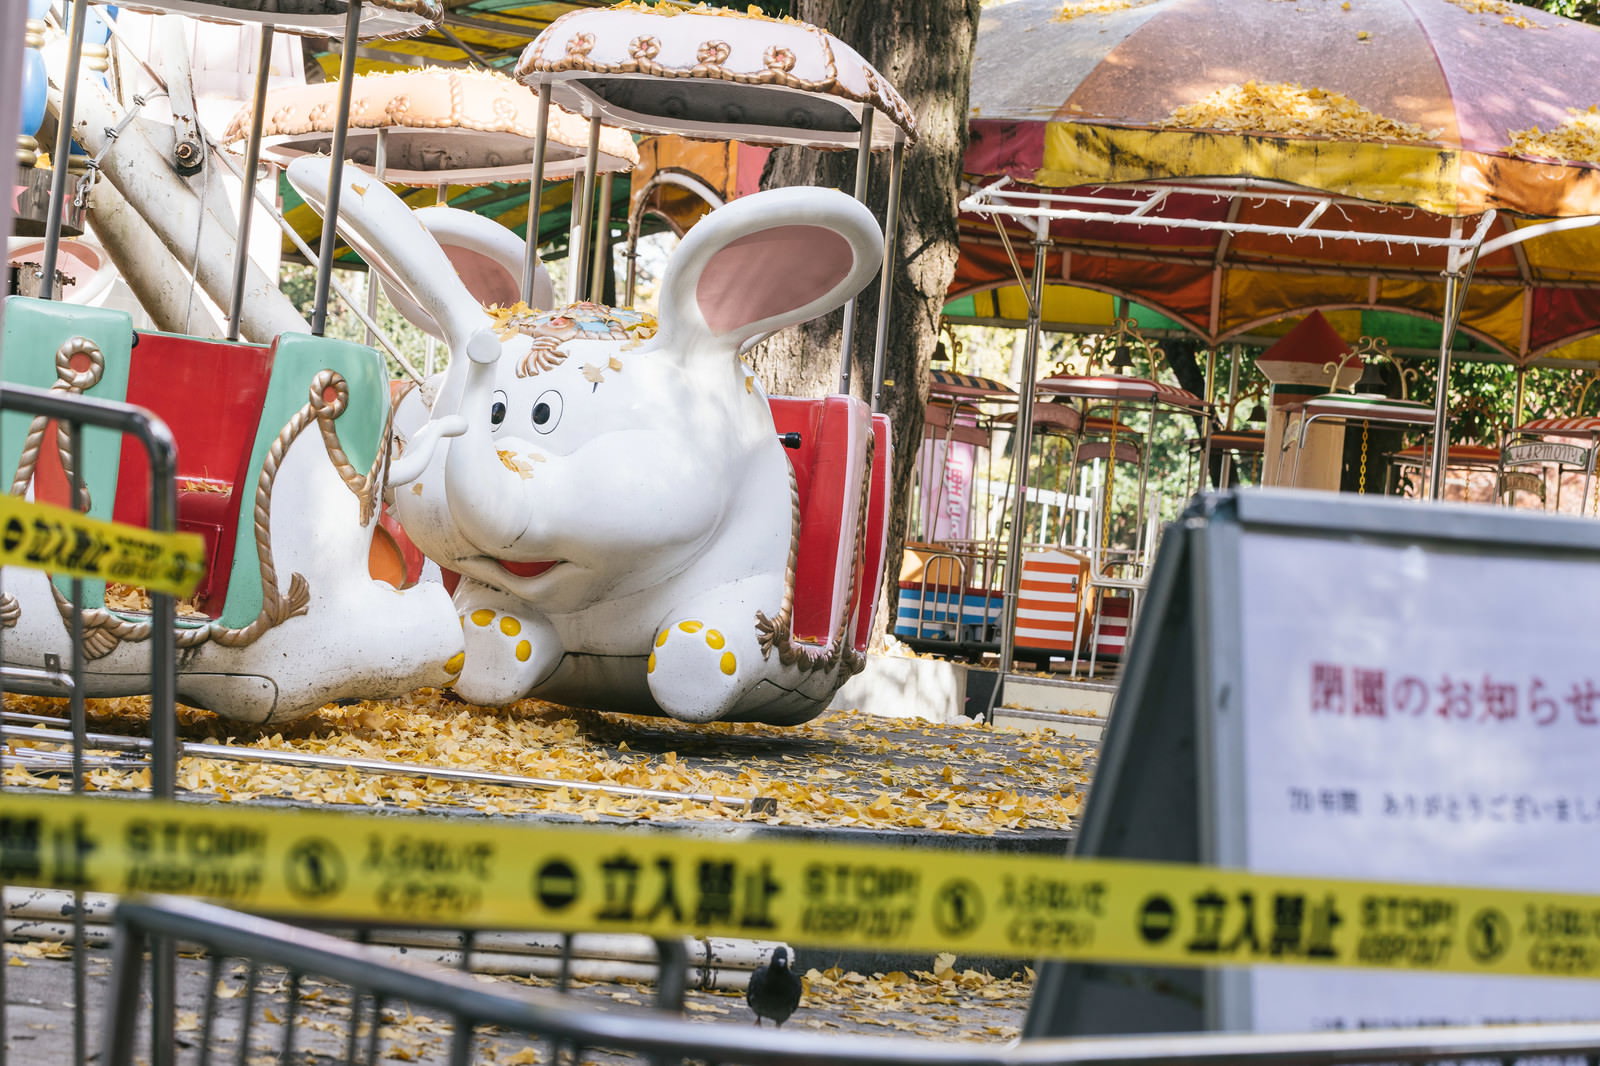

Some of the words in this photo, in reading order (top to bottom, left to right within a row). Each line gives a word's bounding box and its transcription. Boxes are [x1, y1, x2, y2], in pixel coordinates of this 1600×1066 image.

[1311, 662, 1600, 726] 閉園のお知らせ
[1384, 791, 1600, 823] ありがとうございまし
[595, 845, 782, 929] 立入禁止
[804, 861, 920, 899] STOP!
[1187, 886, 1344, 958] 立入禁止
[1361, 896, 1458, 931] STOP!
